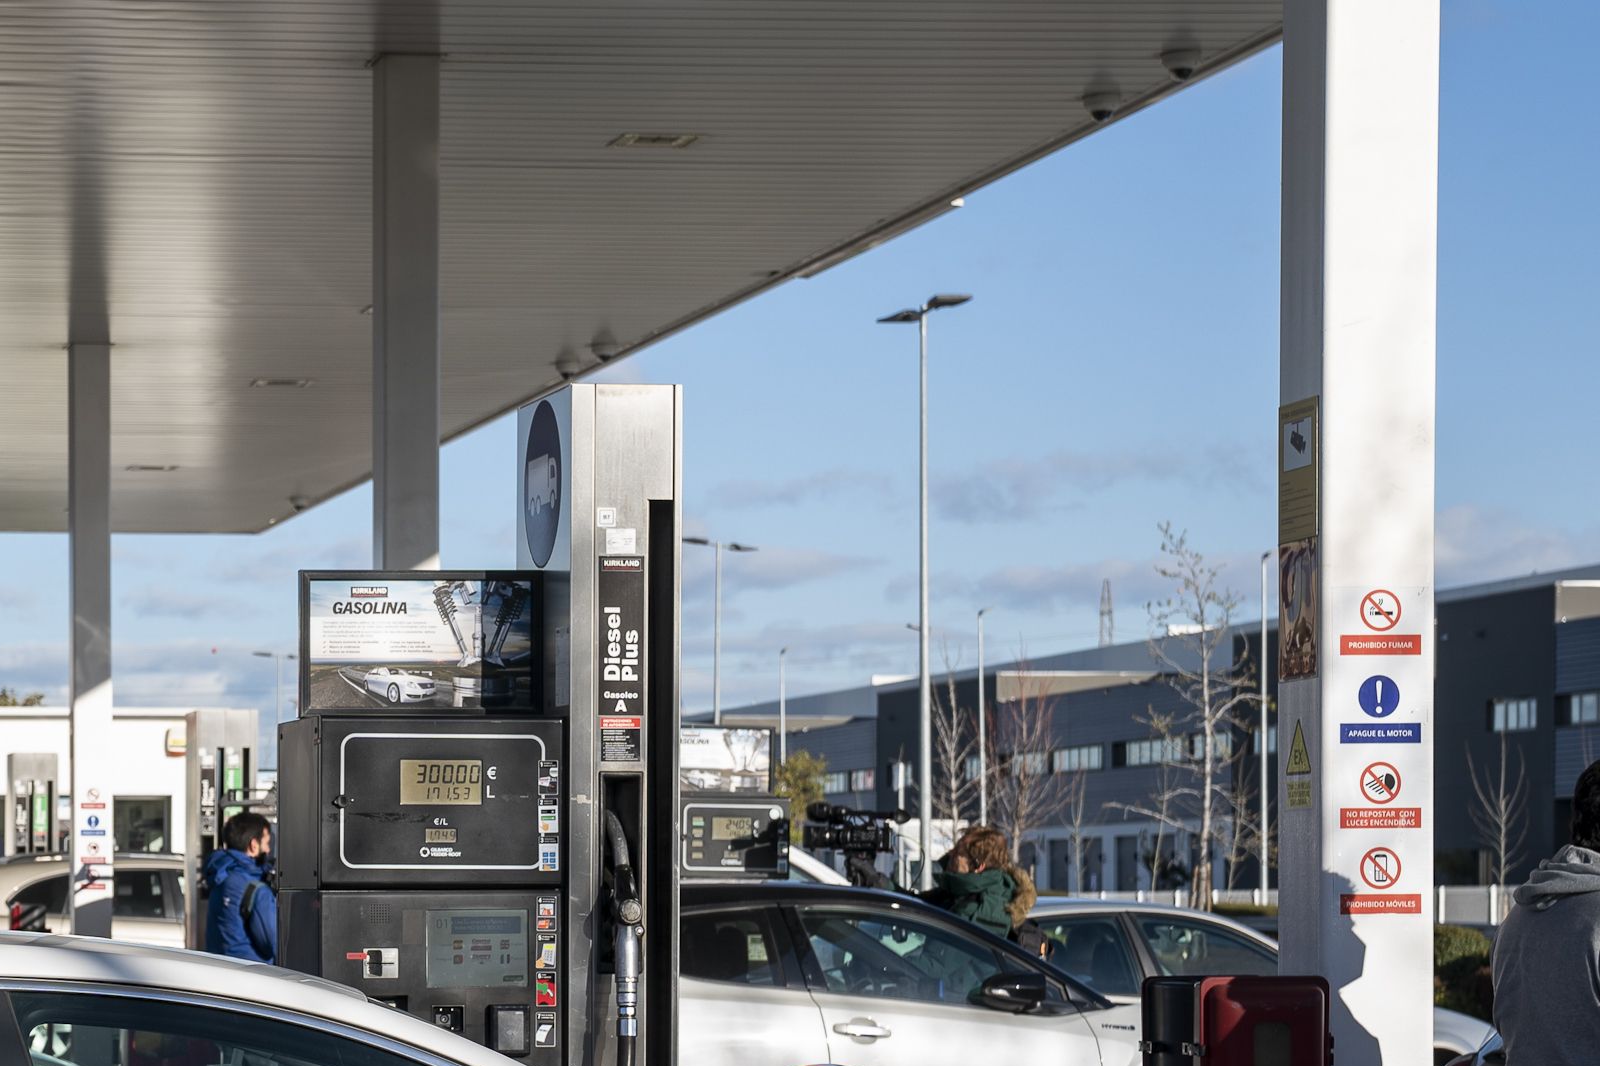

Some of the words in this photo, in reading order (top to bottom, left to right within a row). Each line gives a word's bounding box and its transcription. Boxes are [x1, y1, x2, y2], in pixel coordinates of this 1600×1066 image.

[603, 559, 640, 567] KIRKLAND
[351, 587, 388, 595] KIRKLAND
[332, 601, 408, 615] GASOLINA
[603, 606, 621, 681] Diesel
[1348, 641, 1387, 649] PROHIBIDO
[1389, 641, 1413, 649] FUMAR
[621, 629, 639, 681] Plus
[614, 699, 628, 712] A
[1348, 729, 1376, 738] APAGUE
[1378, 729, 1386, 737] EL
[1387, 729, 1413, 737] MOTOR
[417, 764, 481, 785] 300,00
[486, 766, 497, 780] €
[427, 787, 471, 800] 171,53
[486, 785, 496, 798] L
[1346, 810, 1357, 818] NO
[1359, 810, 1395, 818] REPOSTAR
[1399, 810, 1415, 818] CON
[1346, 818, 1368, 827] LUCES
[1370, 818, 1415, 827] ENCENDIDAS
[1346, 900, 1385, 908] PROHIBIDO
[1386, 898, 1416, 908] MÓVILES
